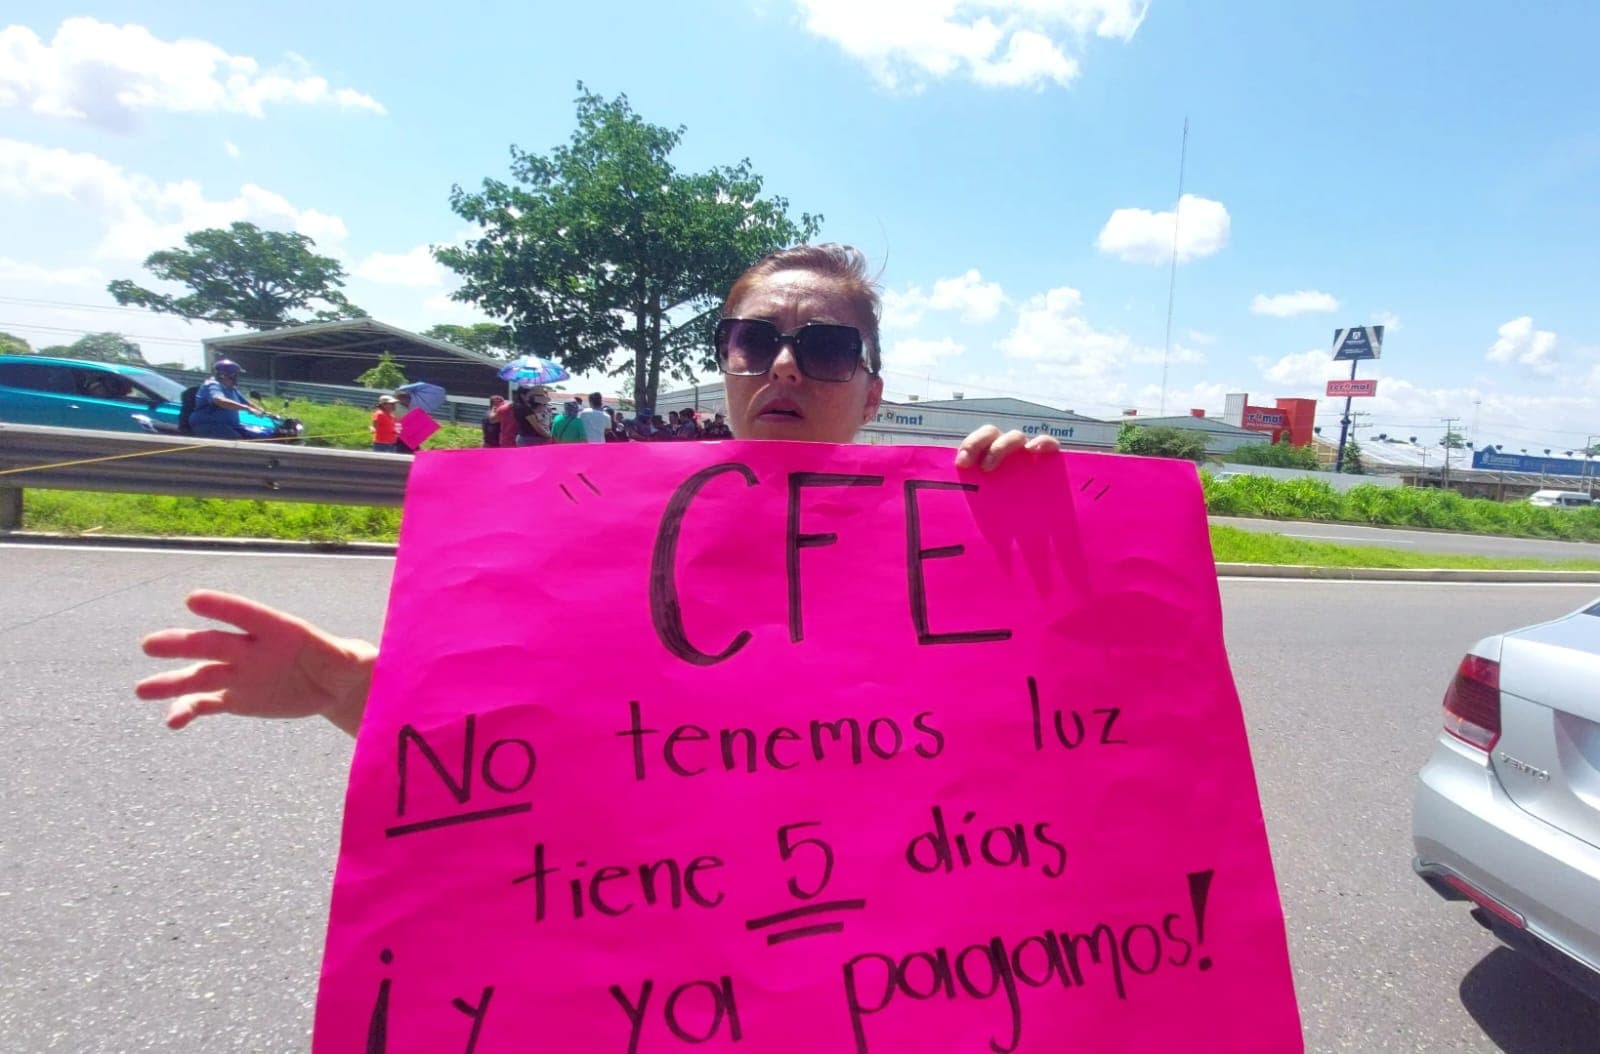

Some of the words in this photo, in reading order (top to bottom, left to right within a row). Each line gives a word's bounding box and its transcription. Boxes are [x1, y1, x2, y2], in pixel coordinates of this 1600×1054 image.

[396, 715, 537, 817] No
[617, 701, 944, 780] tenemos
[1027, 676, 1127, 750] luz
[512, 843, 723, 922] tiene
[777, 822, 833, 900] 5
[906, 806, 1067, 880] días
[609, 976, 742, 1054] ya
[843, 869, 1214, 1054] pagamos!
